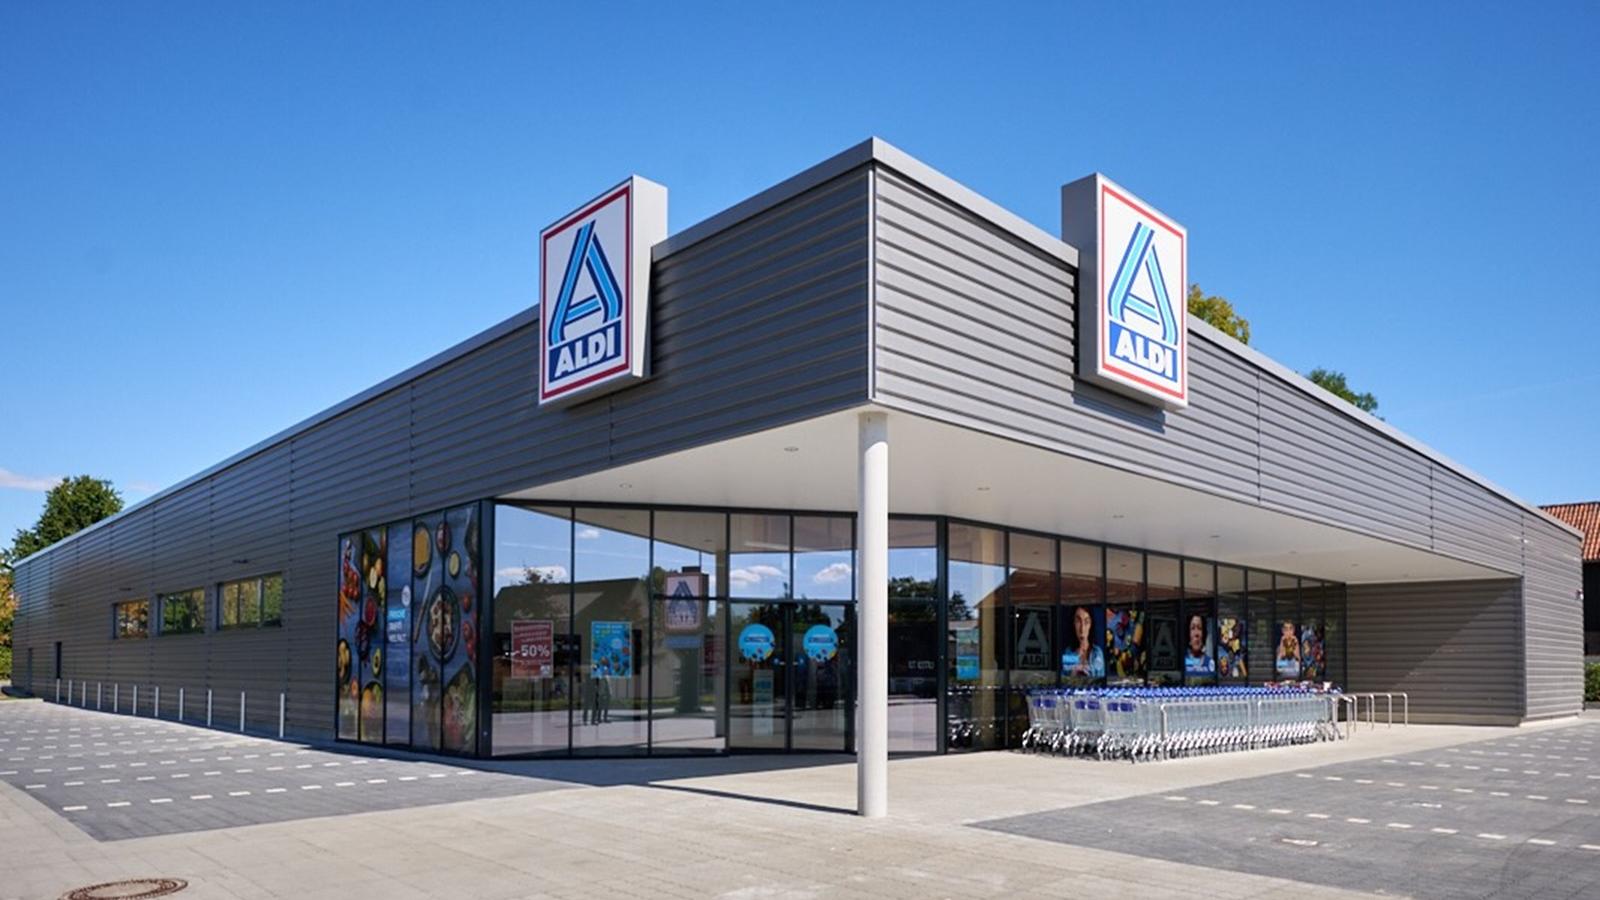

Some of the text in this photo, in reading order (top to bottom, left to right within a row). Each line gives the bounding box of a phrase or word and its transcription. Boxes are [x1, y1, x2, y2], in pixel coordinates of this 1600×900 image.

[554, 326, 616, 378] ALDI
[1114, 328, 1174, 379] ALDI
[521, 644, 551, 657] 50%
